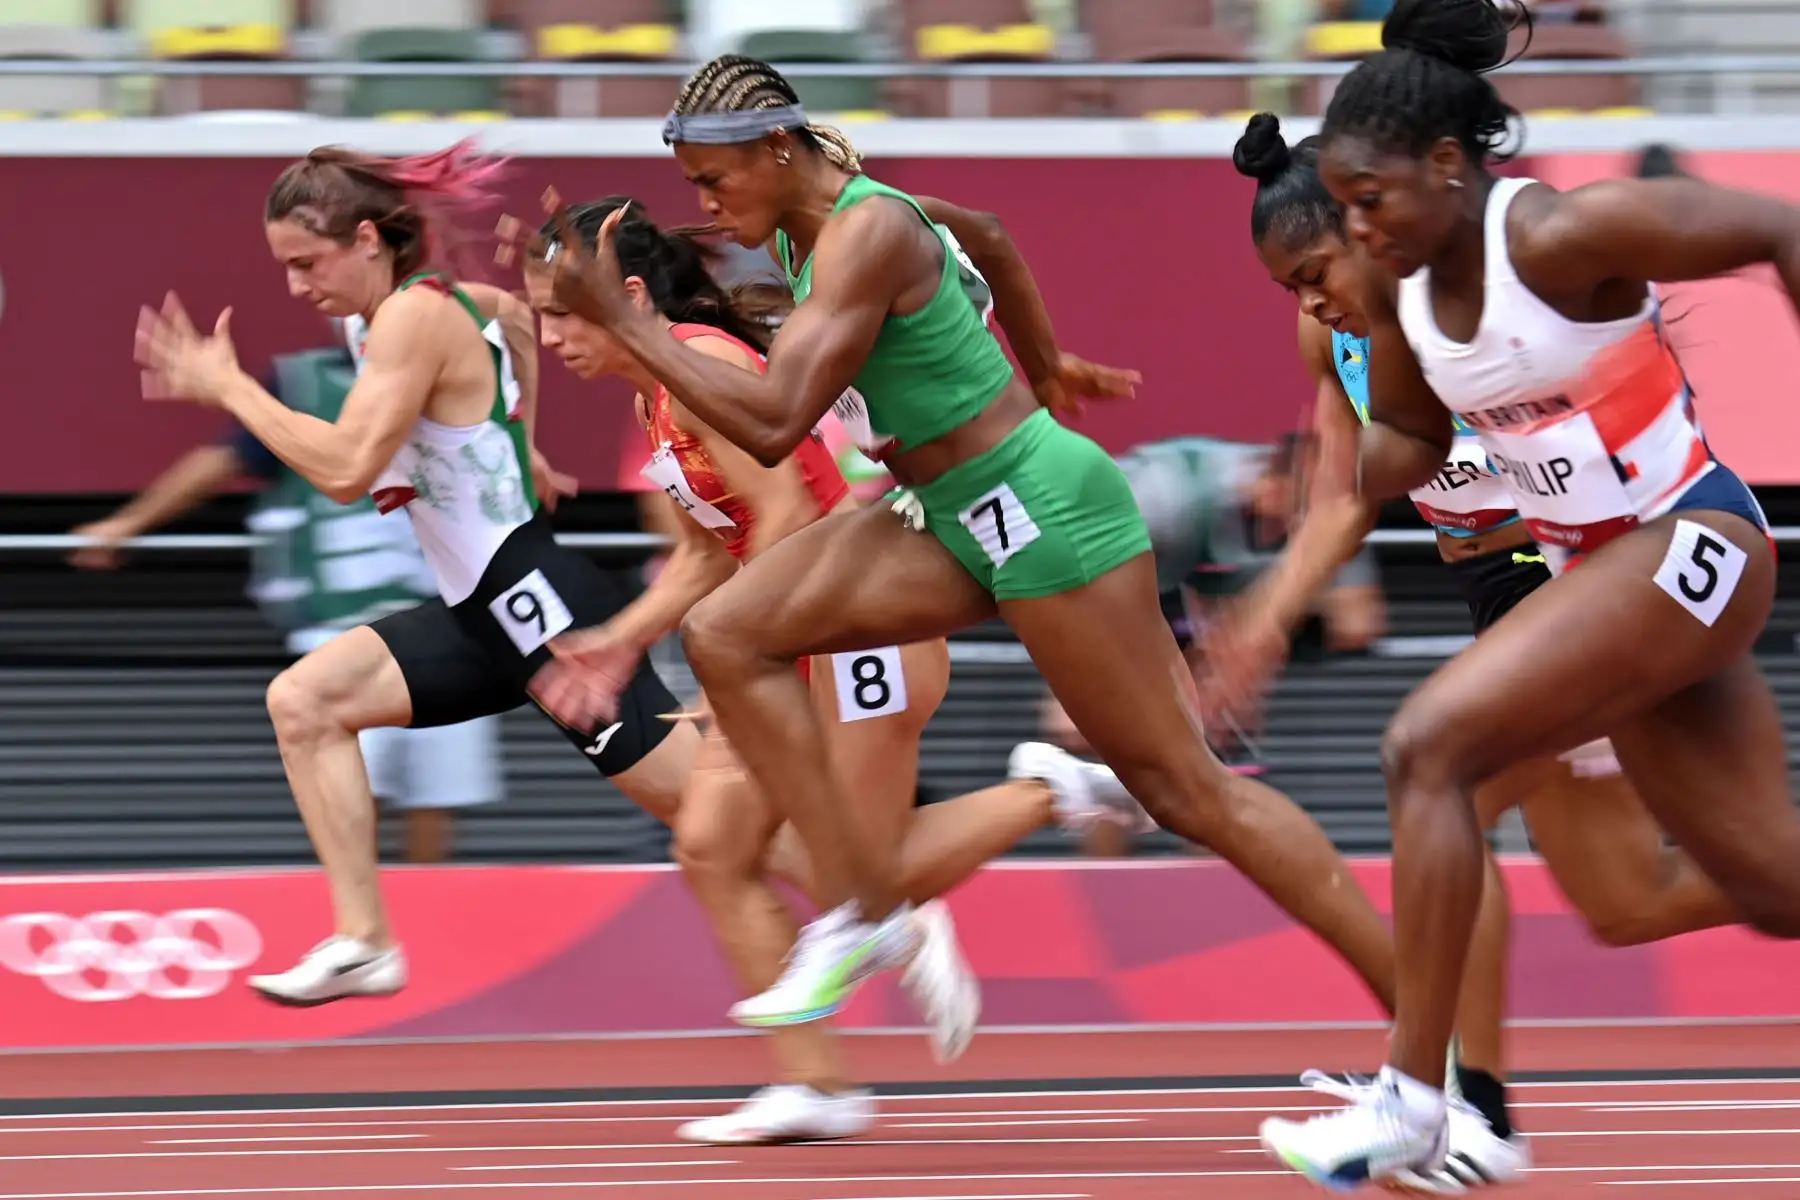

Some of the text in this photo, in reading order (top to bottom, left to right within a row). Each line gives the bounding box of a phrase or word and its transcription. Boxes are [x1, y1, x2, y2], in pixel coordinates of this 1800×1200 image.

[970, 497, 1009, 551] 7
[1678, 532, 1726, 603] 5
[506, 591, 546, 636] 9
[851, 655, 890, 710] 8
